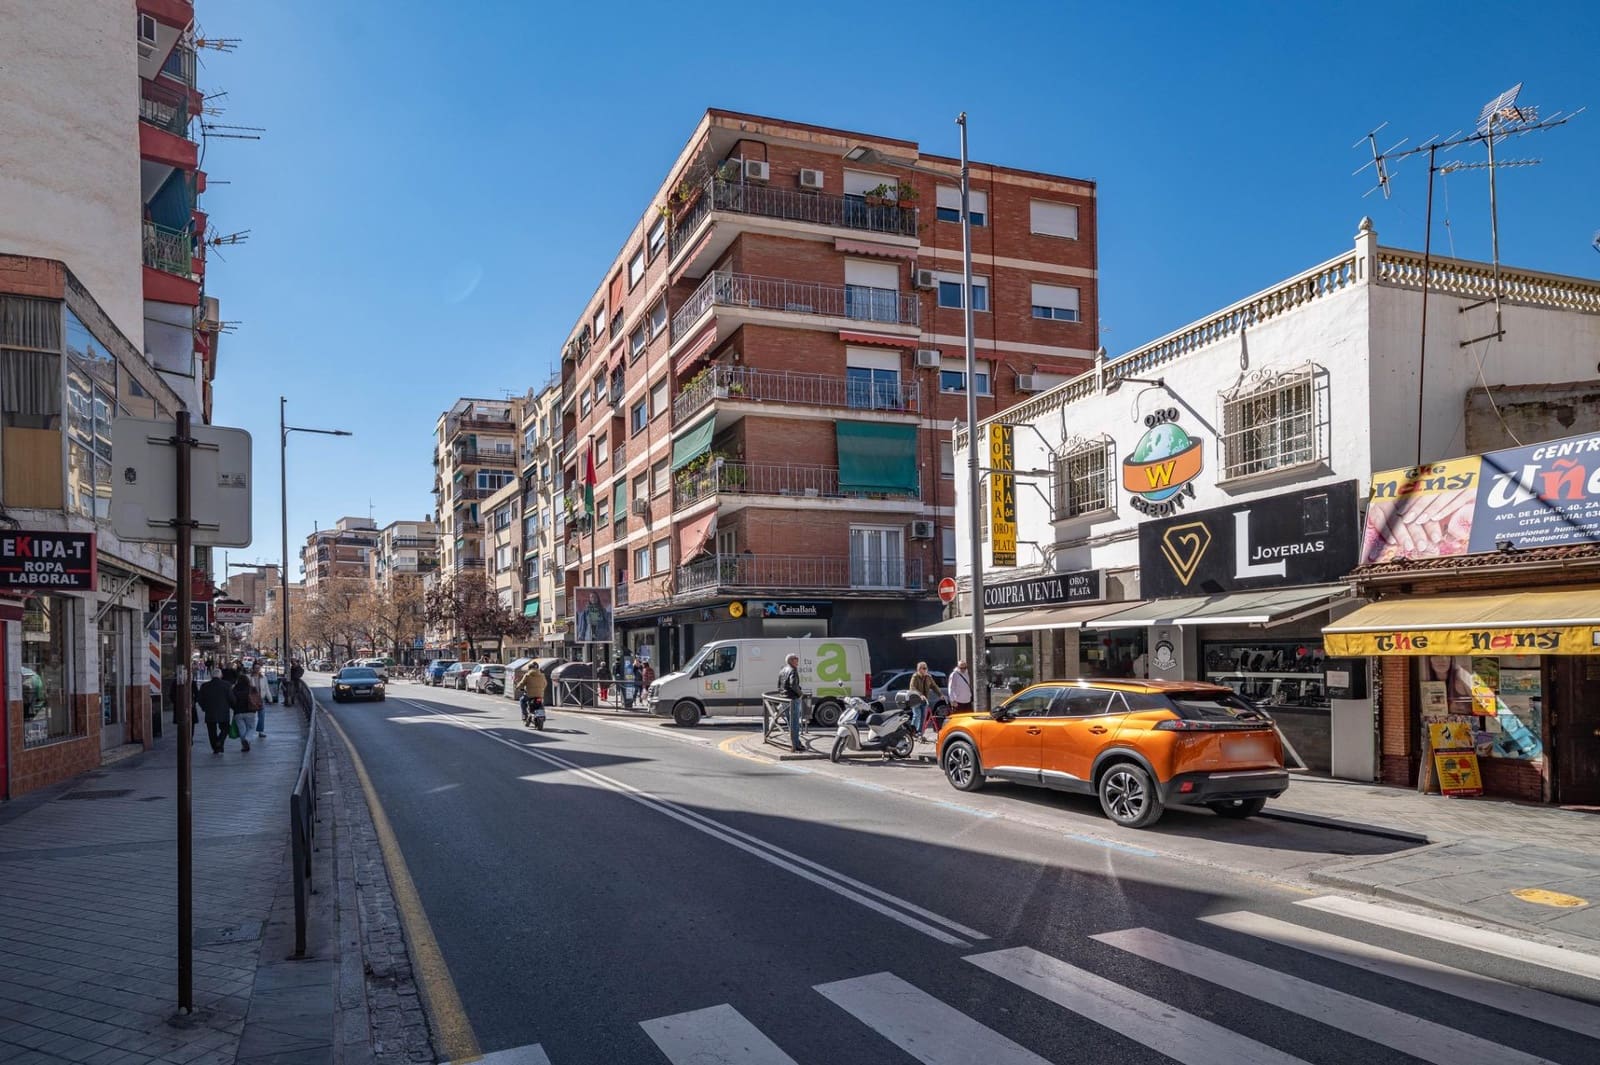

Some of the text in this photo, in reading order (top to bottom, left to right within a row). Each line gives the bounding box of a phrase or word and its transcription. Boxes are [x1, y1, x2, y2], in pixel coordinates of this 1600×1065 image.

[1144, 407, 1180, 428] ORO
[993, 426, 1003, 518] COMPRA
[1003, 428, 1013, 504] VENTA
[1145, 460, 1177, 489] W
[1495, 513, 1516, 521] AVD.
[1519, 510, 1600, 526] CITA PREVIA: 63
[994, 523, 1008, 535] ORO
[1495, 522, 1599, 540] Extensiones humanas
[3, 537, 85, 558] EKIPA-T
[994, 540, 1016, 551] PLATA
[1232, 509, 1287, 580] L
[24, 561, 64, 573] ROPA
[9, 572, 79, 585] LABORAL
[1069, 577, 1084, 586] ORO
[984, 580, 1064, 605] COMPRA VENTA
[1069, 586, 1091, 596] PLATA
[779, 604, 817, 615] CaixaBank
